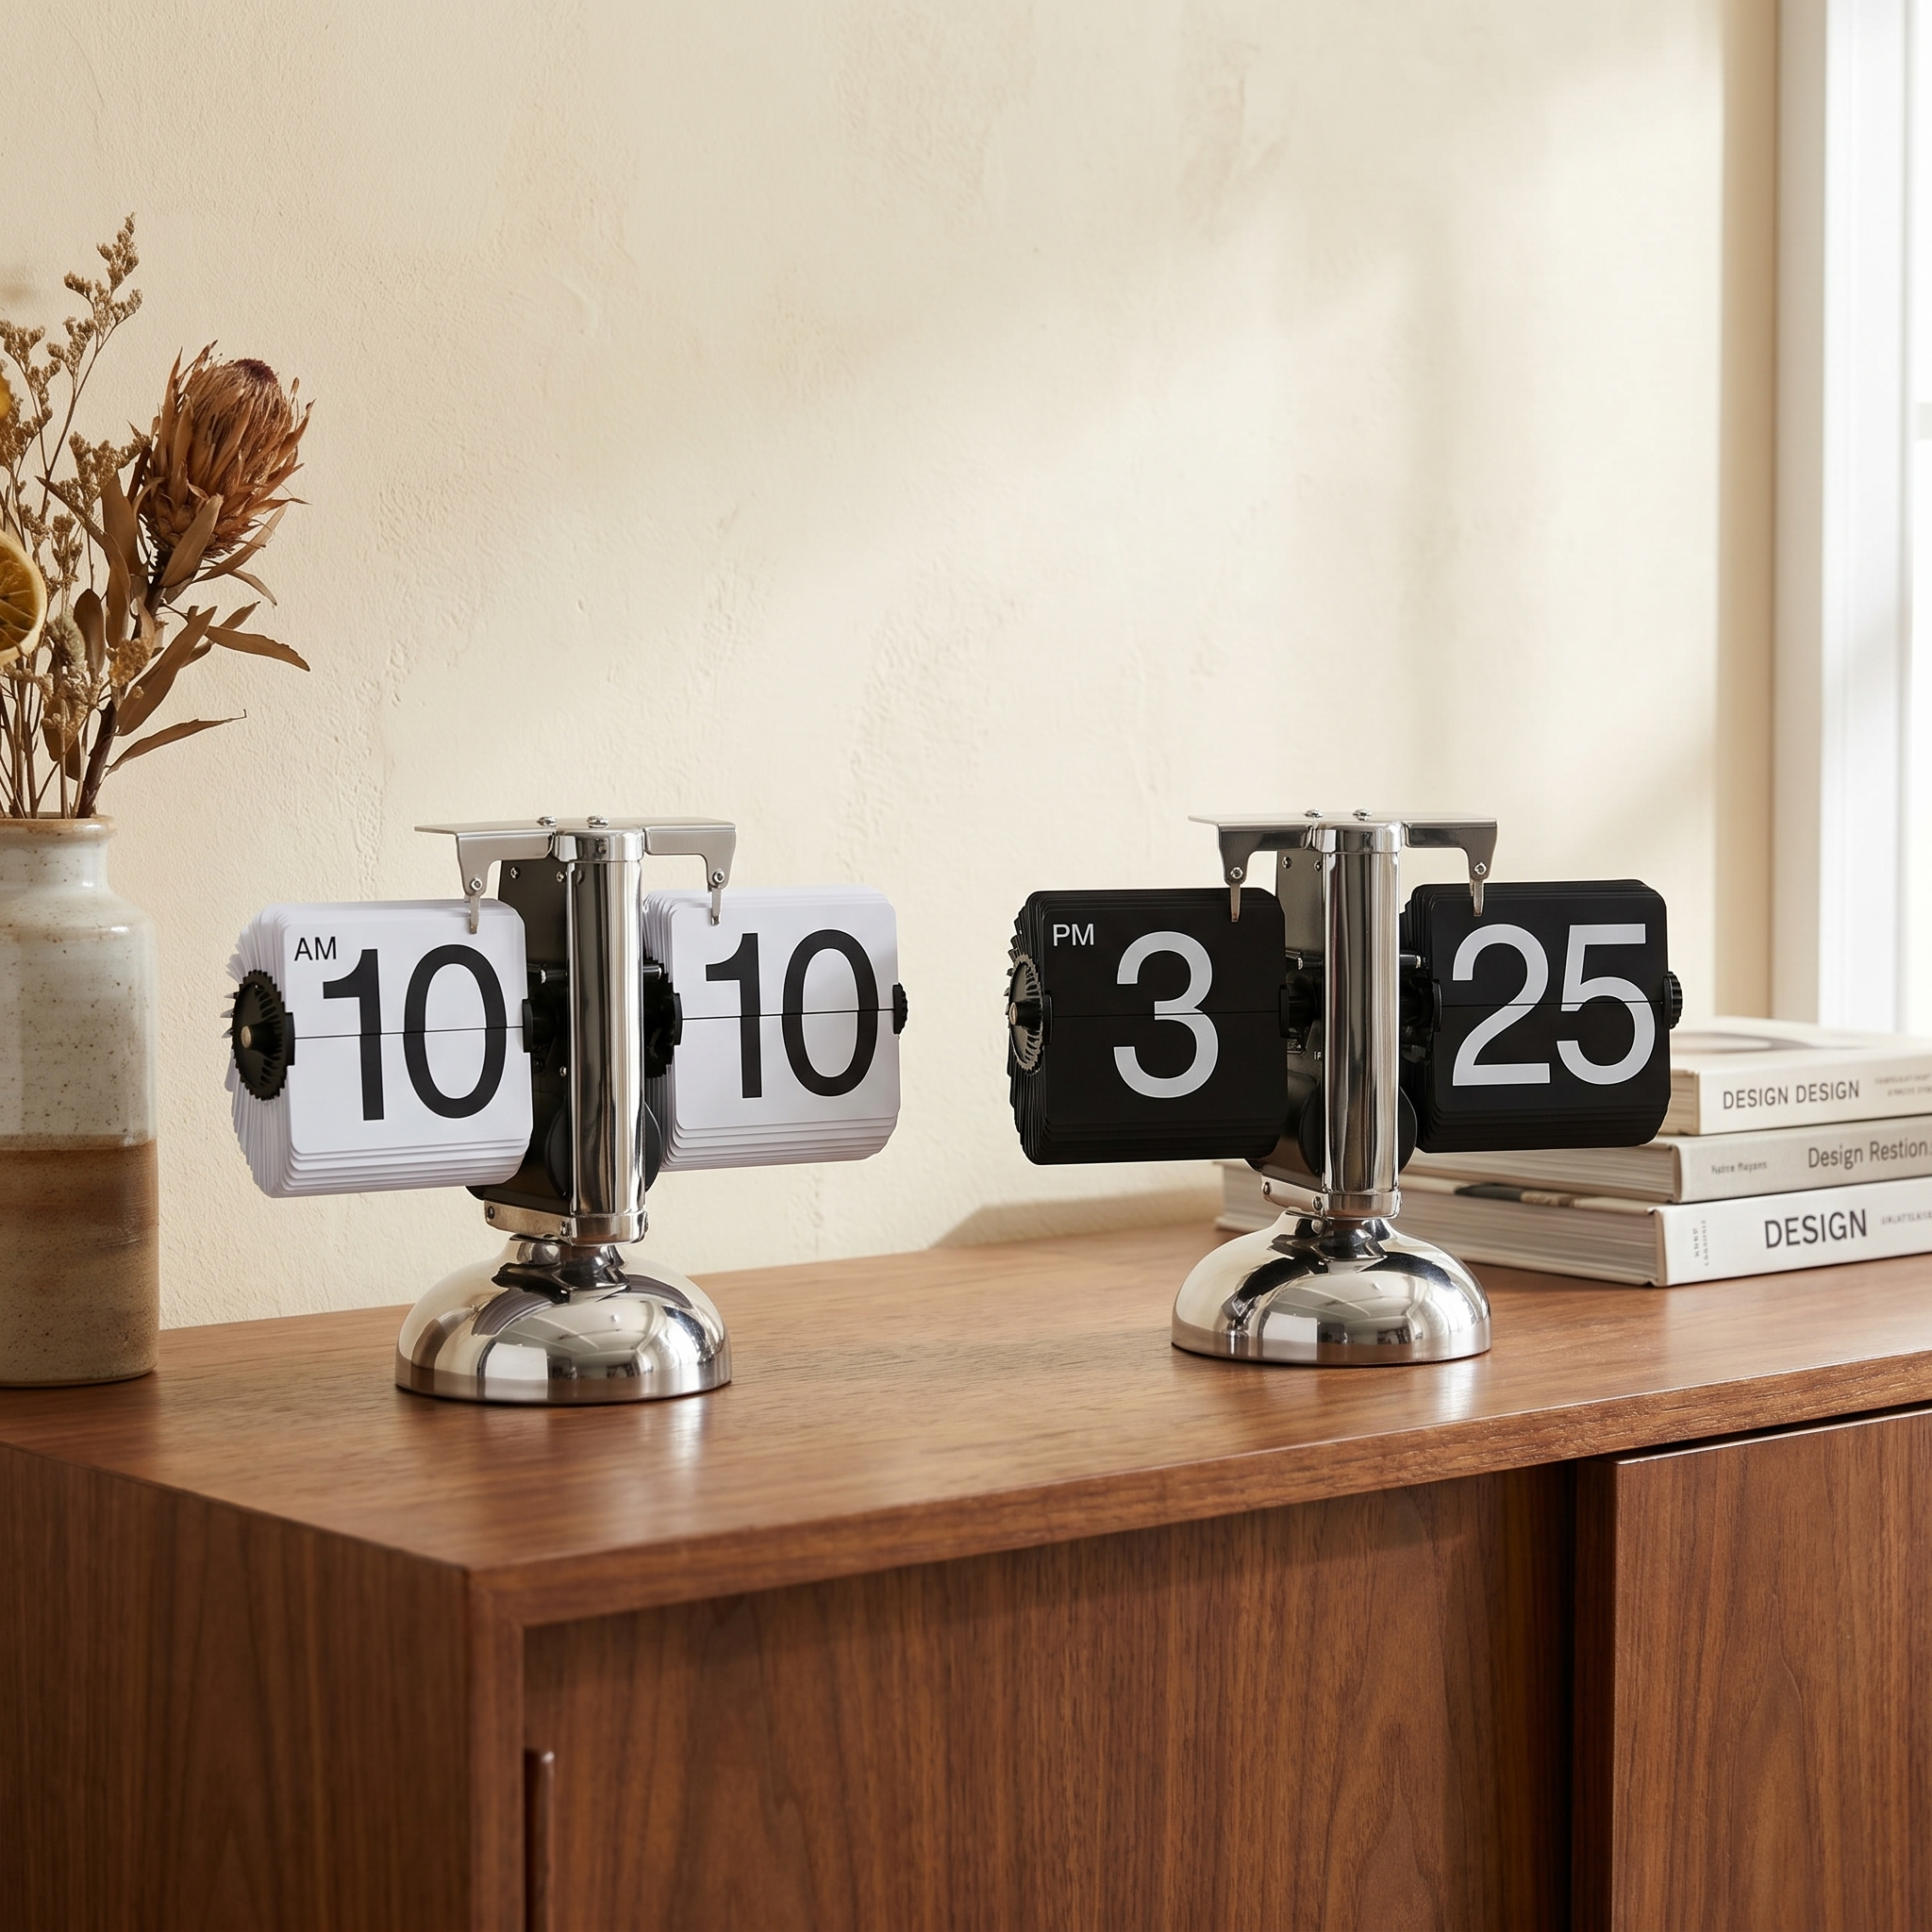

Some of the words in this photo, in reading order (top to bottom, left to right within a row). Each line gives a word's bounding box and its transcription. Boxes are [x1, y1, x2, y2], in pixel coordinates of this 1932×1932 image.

[293, 936, 337, 961] AM
[1052, 923, 1094, 947] PM
[705, 928, 880, 1099] 10
[1113, 930, 1219, 1099] 3
[1451, 923, 1657, 1087] 25
[322, 943, 508, 1122] 10
[1723, 1087, 1789, 1110] DESIGN
[1795, 1080, 1860, 1105] DESIGN
[1807, 1143, 1864, 1171] Design
[1869, 1137, 1932, 1162] Restion
[1763, 1208, 1868, 1249] DESIGN
